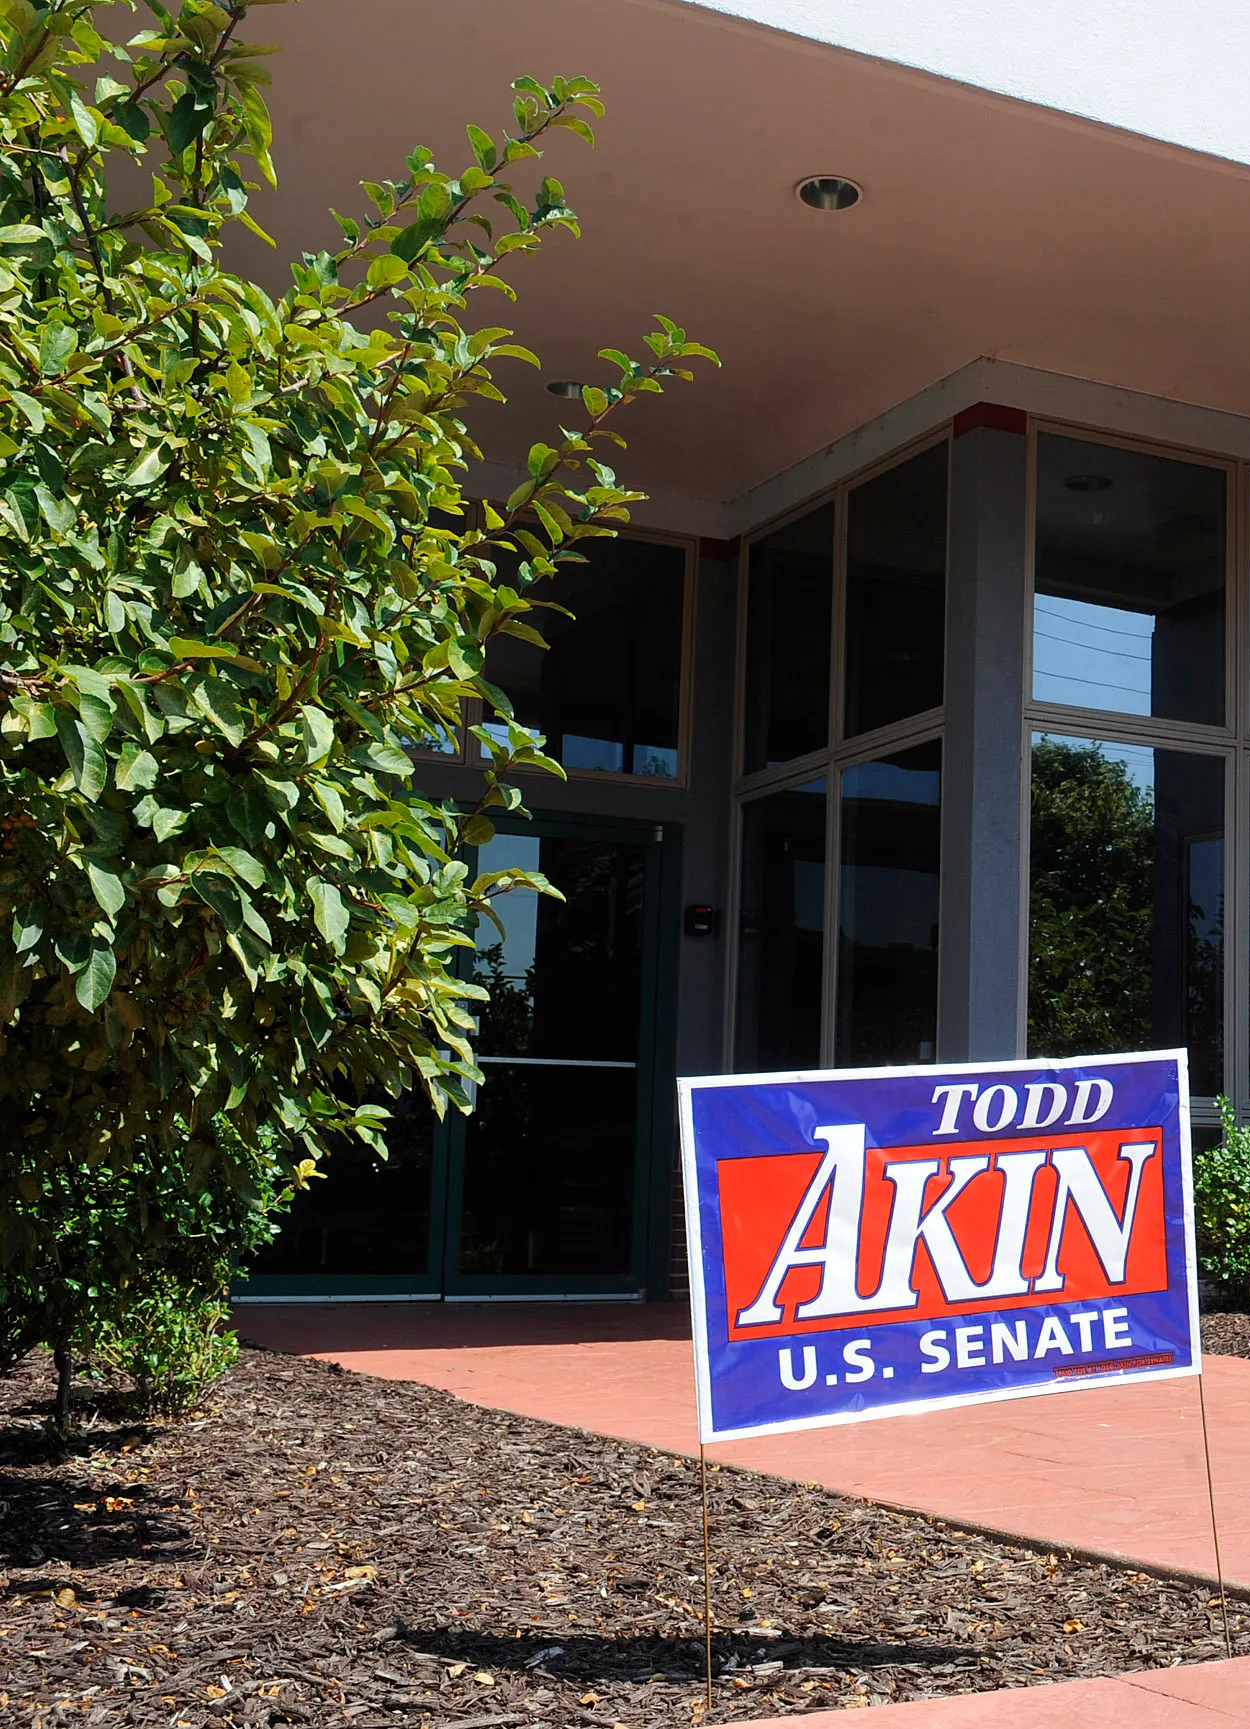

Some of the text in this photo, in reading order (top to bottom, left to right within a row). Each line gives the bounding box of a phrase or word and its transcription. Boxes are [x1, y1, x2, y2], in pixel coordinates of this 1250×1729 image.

[932, 1080, 1113, 1135] TODD
[738, 1123, 1156, 1326] AKIN
[779, 1308, 1132, 1390] U.S. SENATE
[1134, 1358, 1145, 1367] FOR
